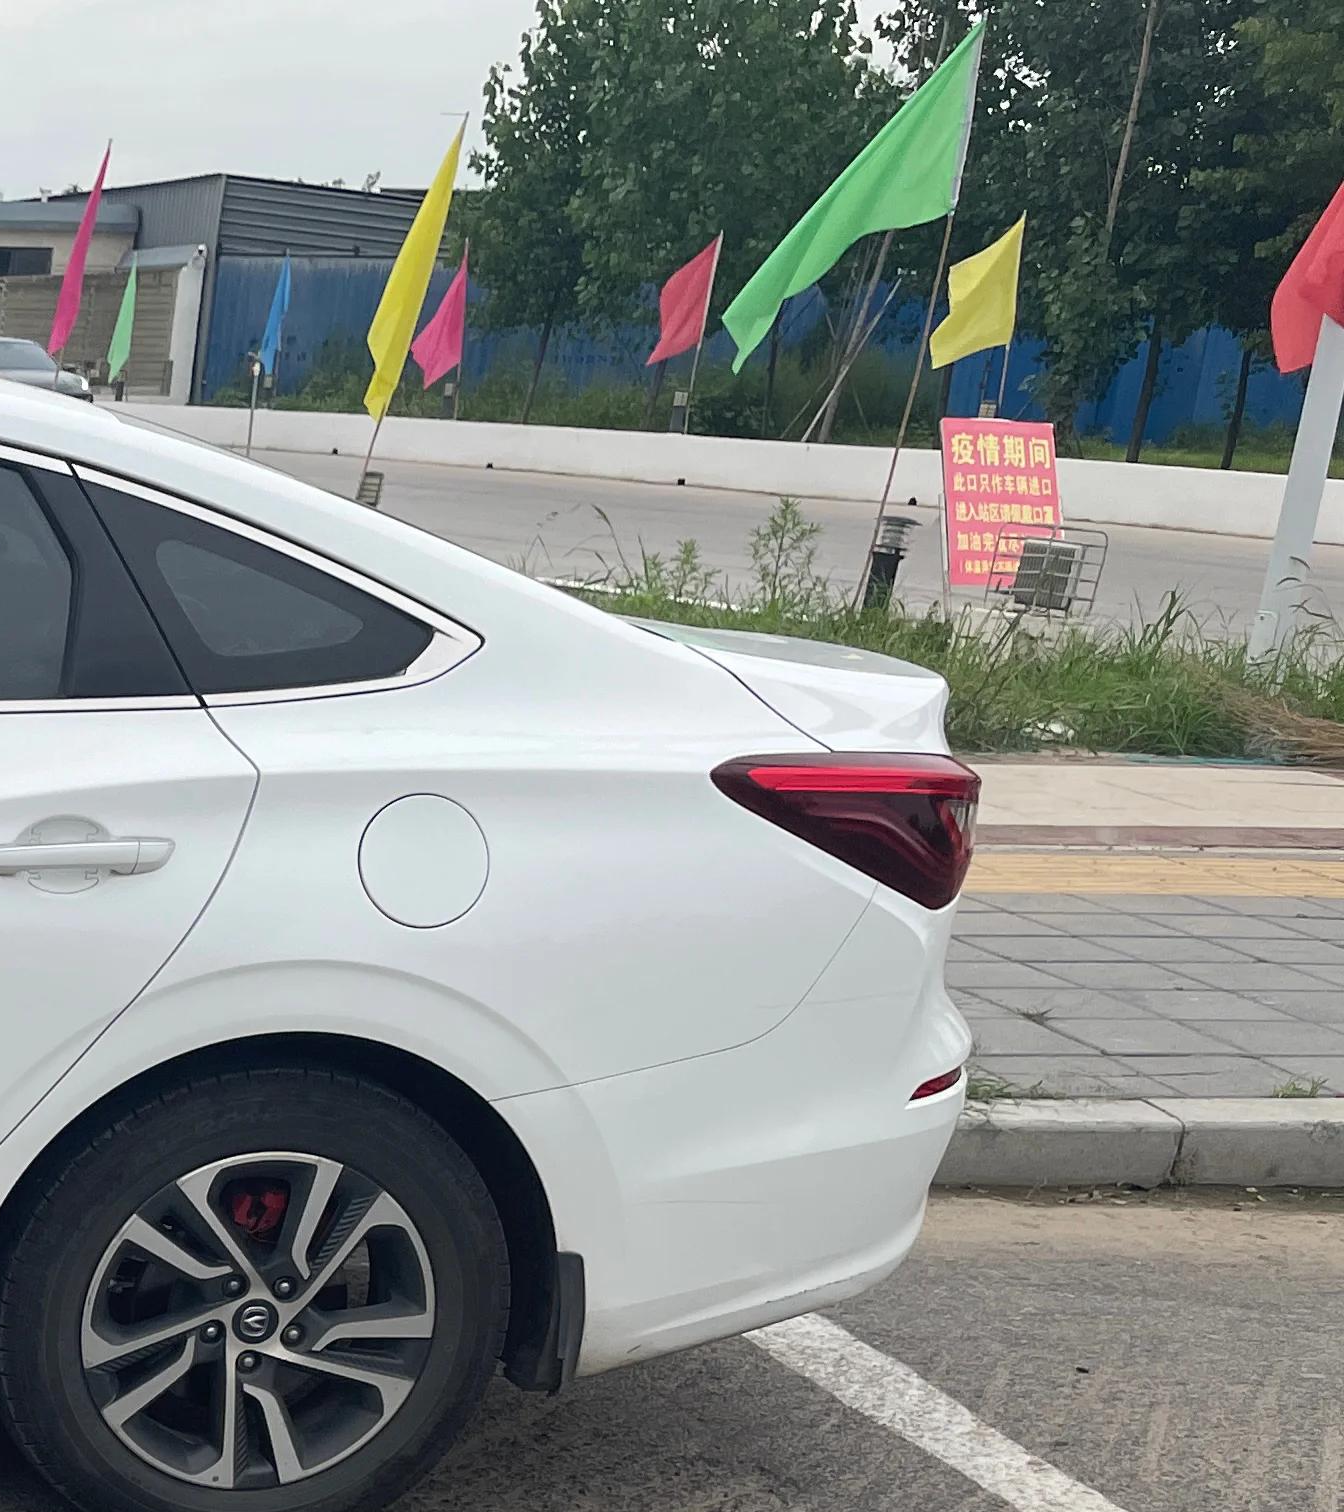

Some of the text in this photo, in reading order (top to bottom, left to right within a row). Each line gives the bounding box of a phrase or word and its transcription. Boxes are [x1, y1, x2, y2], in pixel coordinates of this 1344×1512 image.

[951, 433, 1050, 468] 疫情期间
[953, 472, 1052, 495] 此口只作车辆进口
